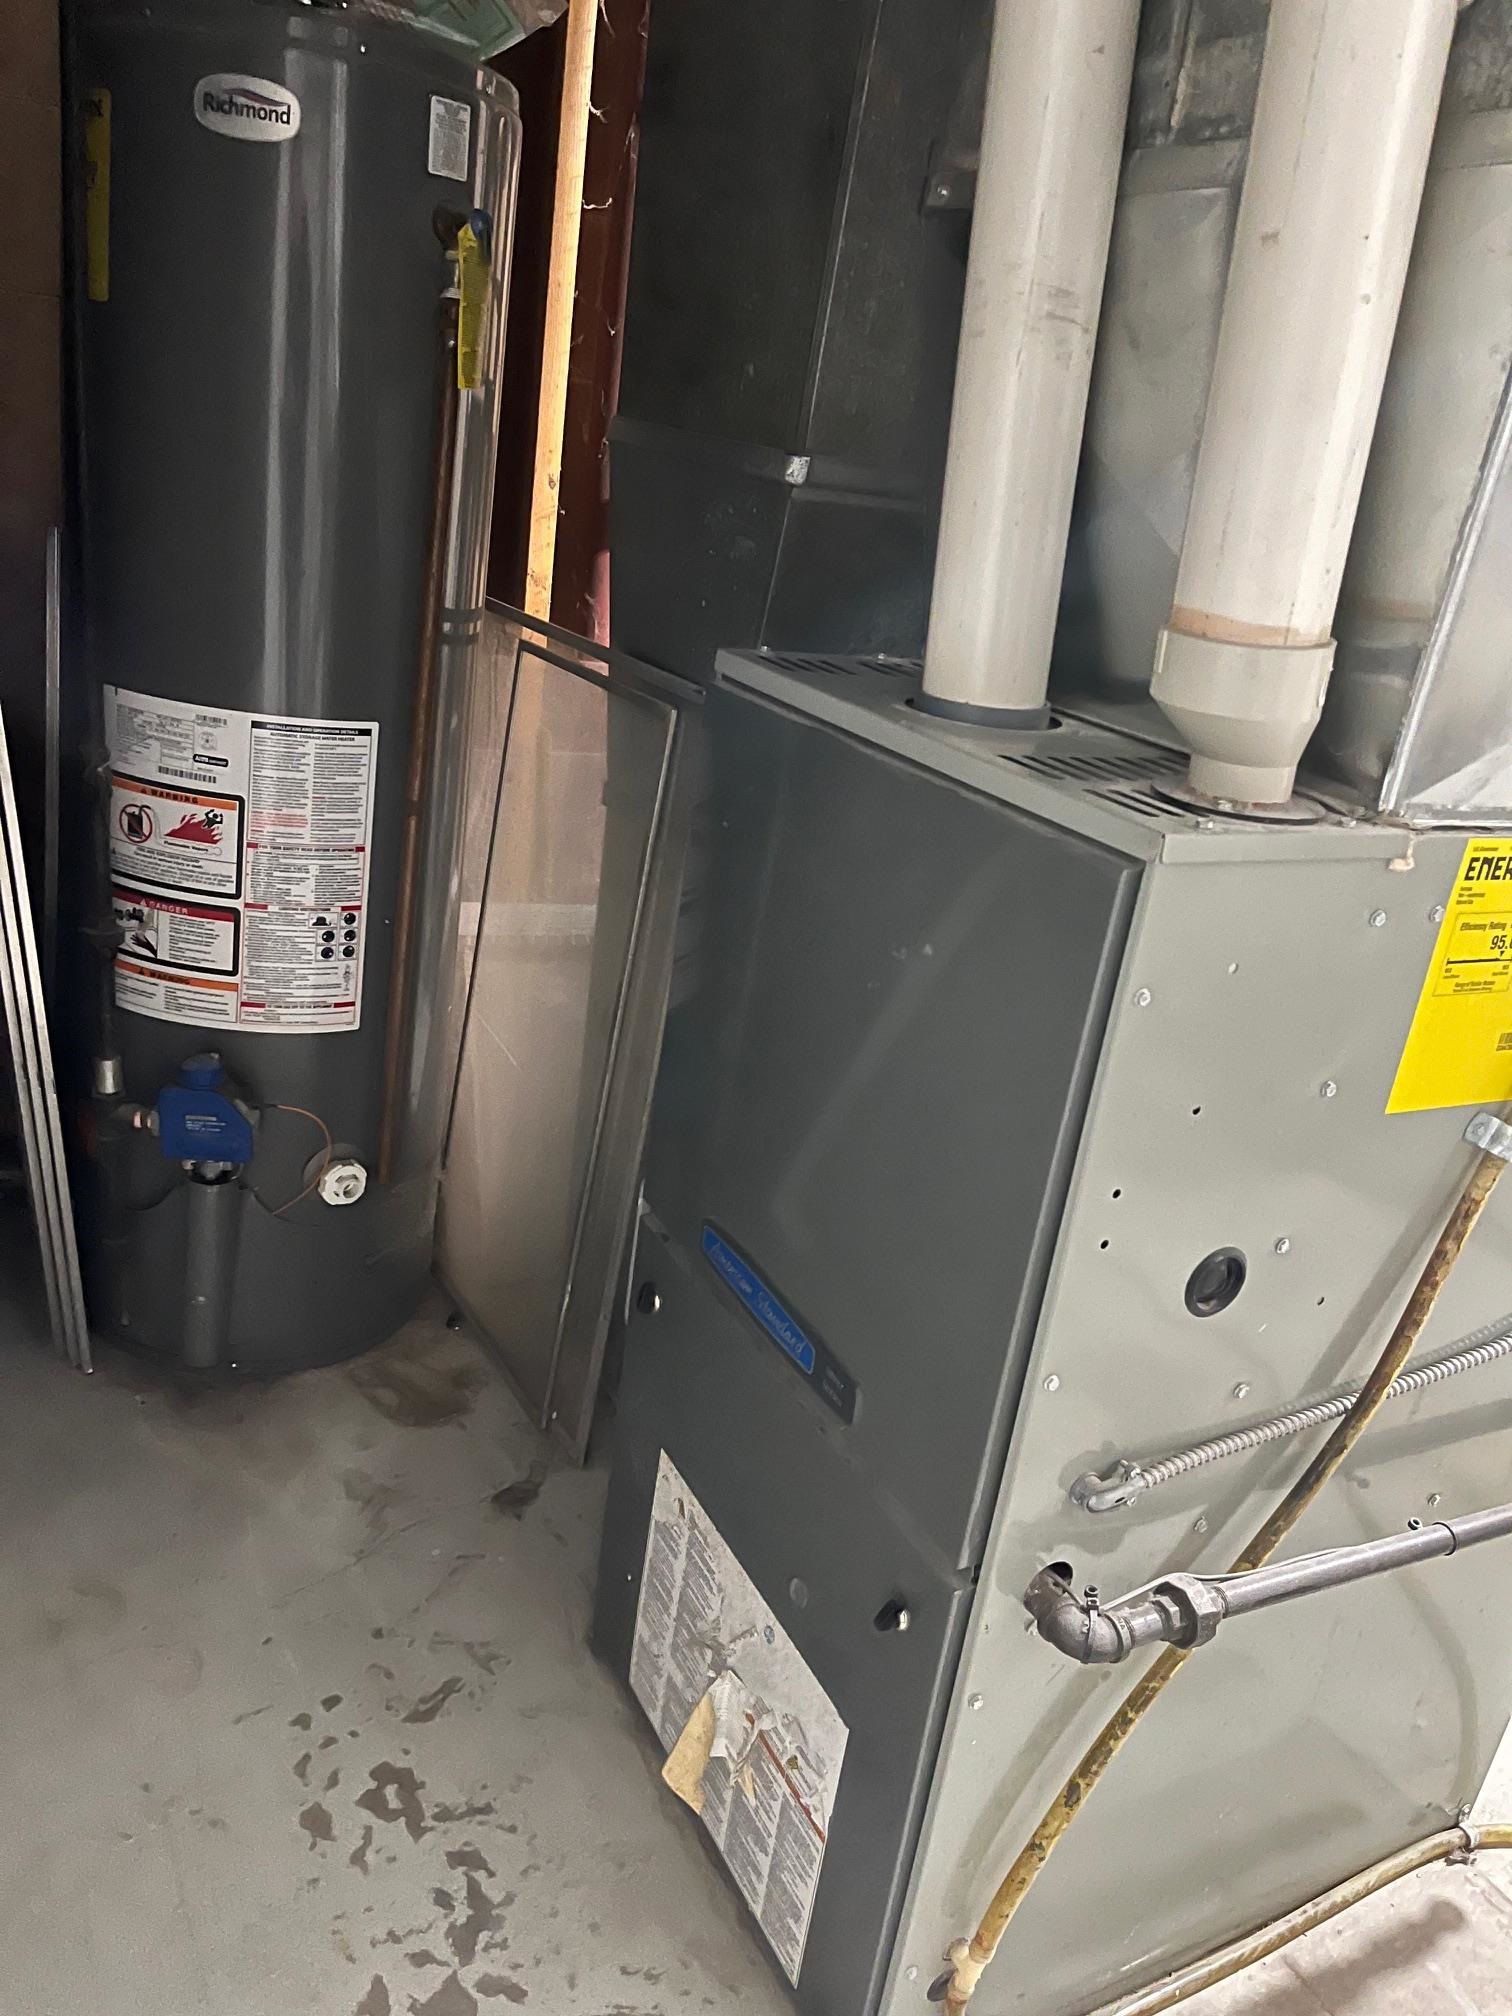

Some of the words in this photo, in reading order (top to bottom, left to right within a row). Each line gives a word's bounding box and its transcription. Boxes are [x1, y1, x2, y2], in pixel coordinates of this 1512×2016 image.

[202, 91, 291, 125] Richmond
[151, 788, 199, 804] WARNING
[148, 900, 188, 915] DANGER
